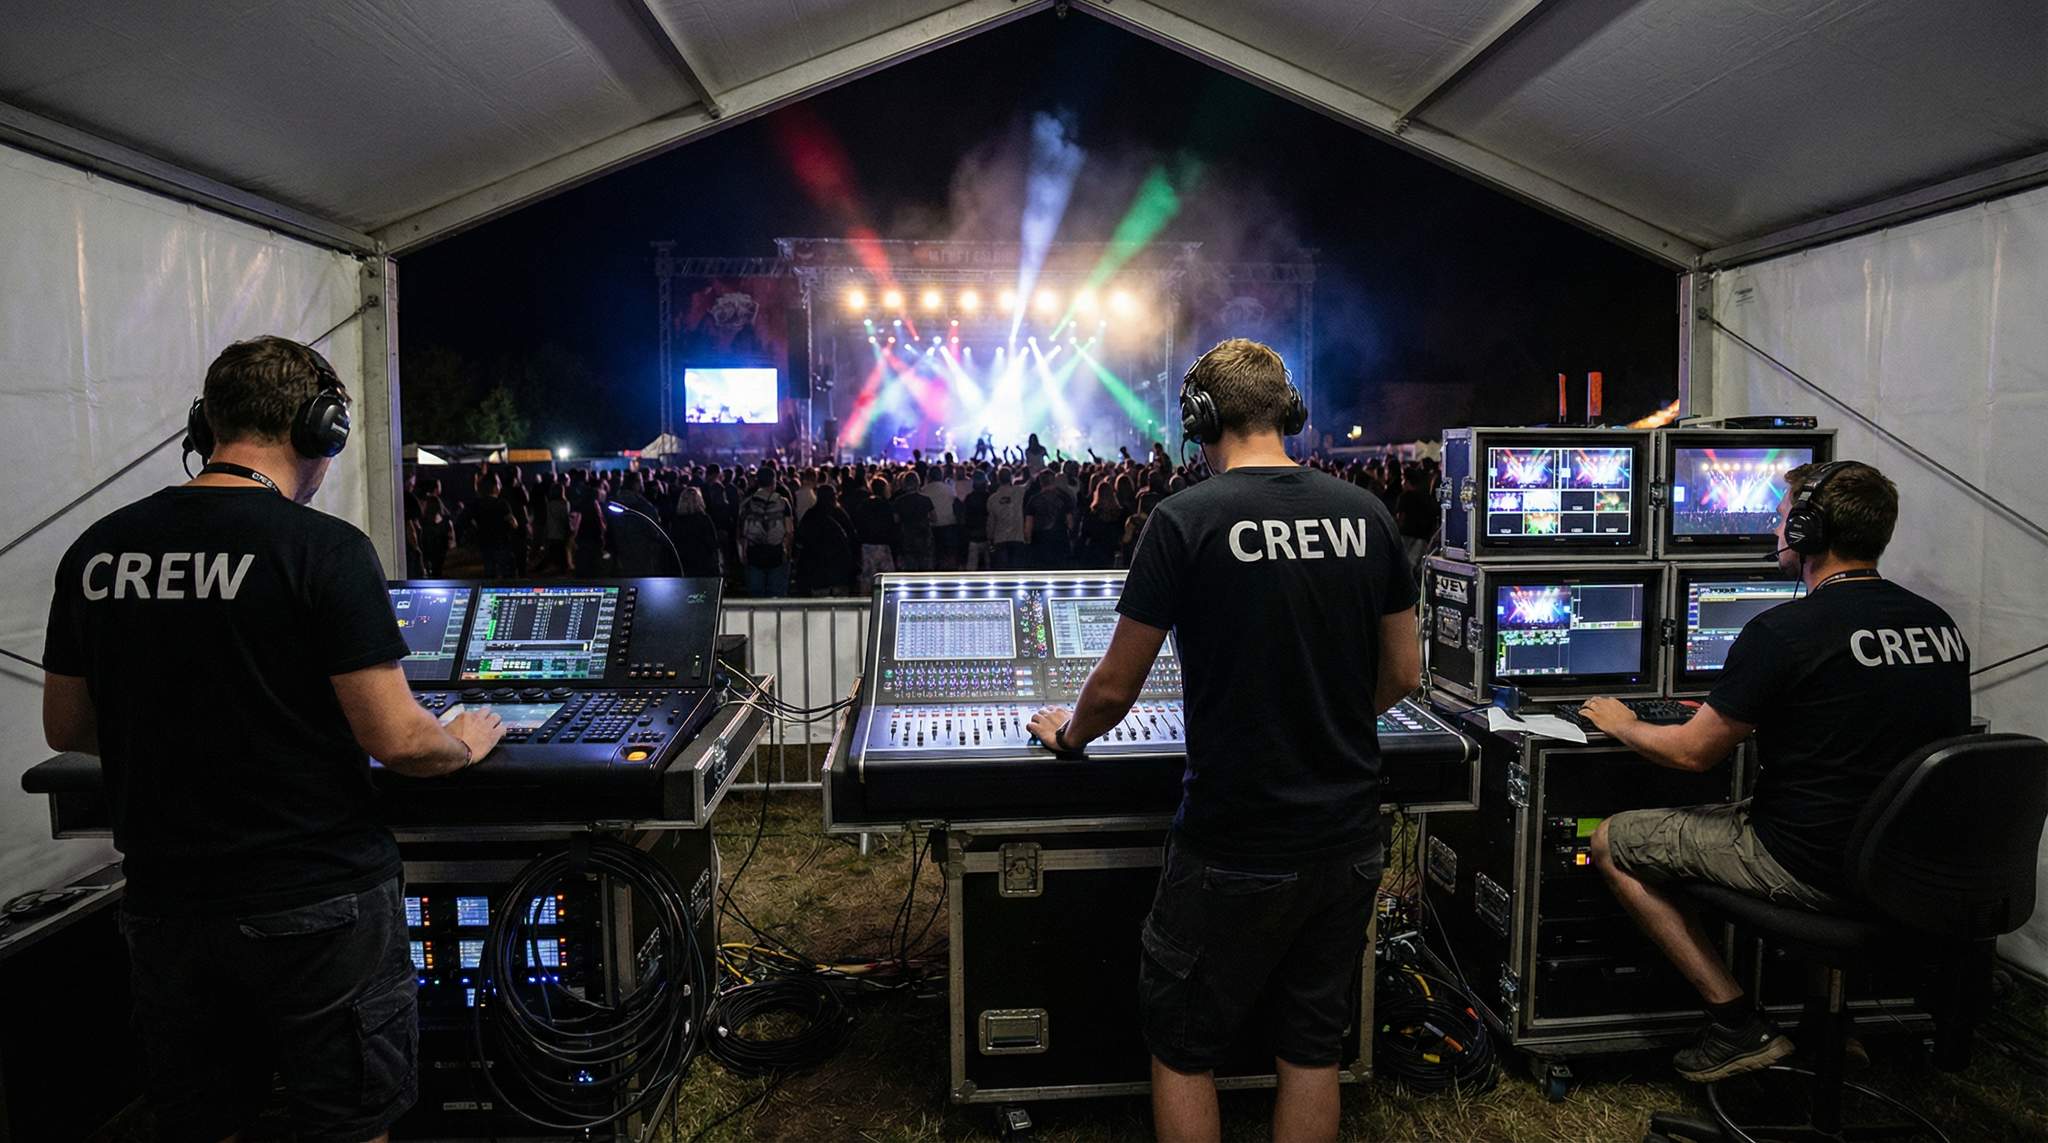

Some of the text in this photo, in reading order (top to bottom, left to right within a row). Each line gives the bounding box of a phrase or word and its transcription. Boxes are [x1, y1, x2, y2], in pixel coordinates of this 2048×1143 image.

[1228, 518, 1366, 562] CREW
[82, 552, 255, 600] CREW
[1850, 626, 1965, 667] CREW
